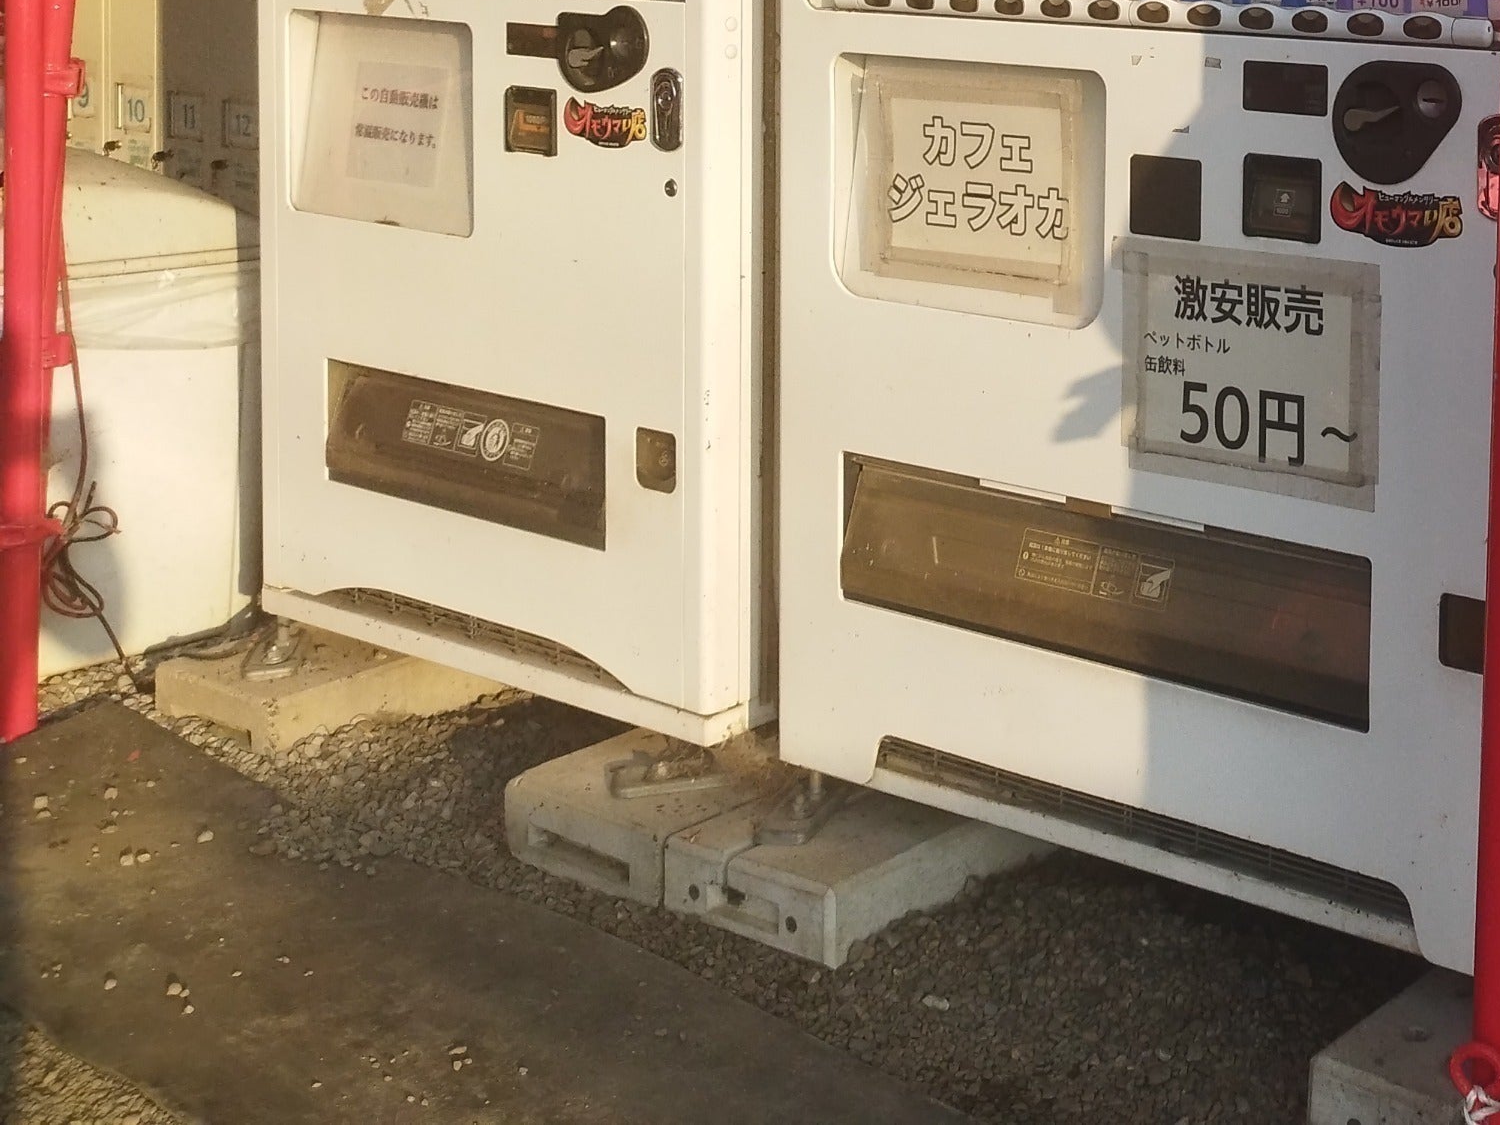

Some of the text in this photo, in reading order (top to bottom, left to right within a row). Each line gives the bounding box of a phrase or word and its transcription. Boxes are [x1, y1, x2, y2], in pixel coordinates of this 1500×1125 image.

[127, 98, 145, 123] 10
[361, 87, 439, 110] この自動販売機は
[564, 98, 646, 146] オモウマい店
[923, 116, 1033, 173] カフェ
[888, 173, 1070, 240] ジェラオカ
[1174, 274, 1324, 336] 激安販売
[1143, 331, 1231, 355] ペットボトル
[1144, 354, 1186, 377] 缶飲料
